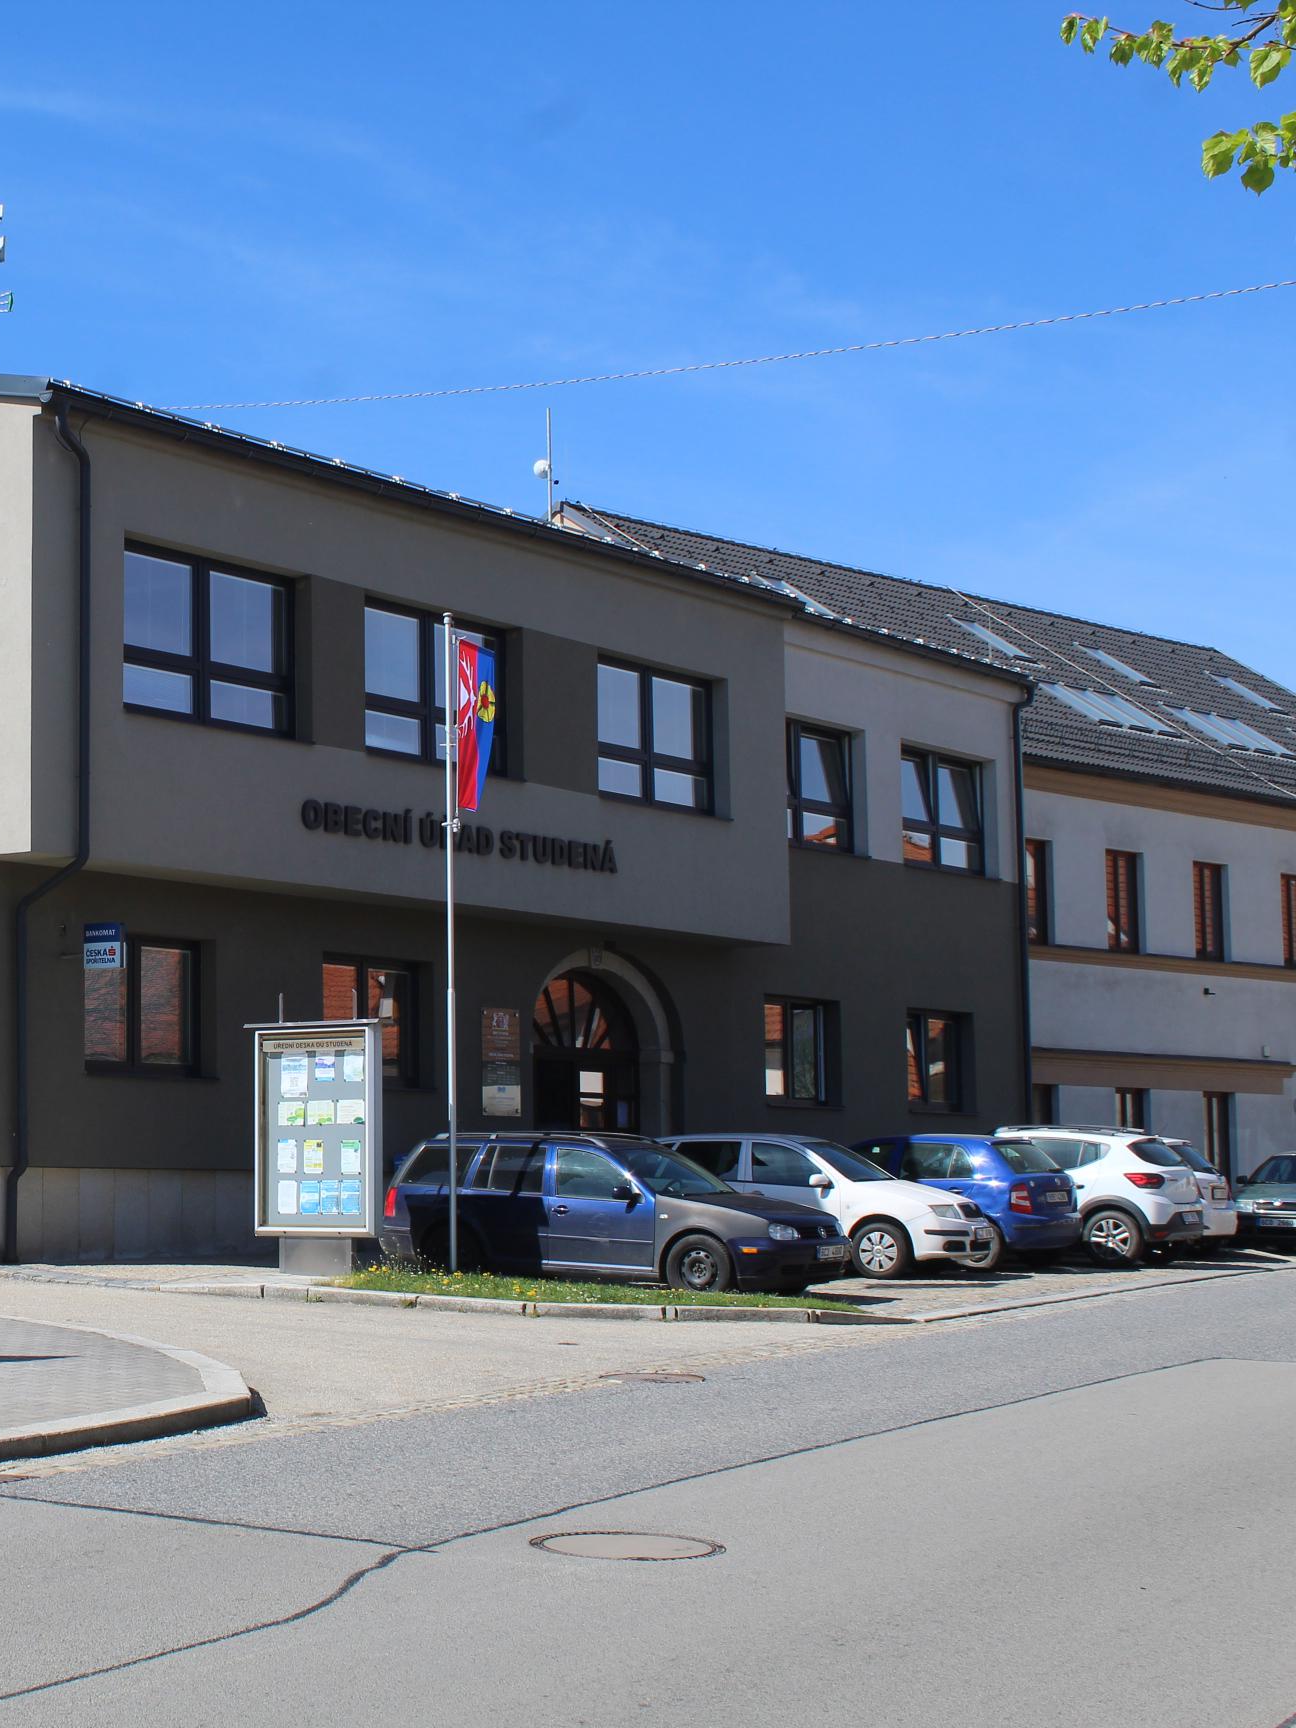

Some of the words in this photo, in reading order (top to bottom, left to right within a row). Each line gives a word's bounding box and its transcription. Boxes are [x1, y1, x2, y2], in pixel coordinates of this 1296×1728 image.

[301, 799, 414, 846] OBECNÍ
[498, 828, 619, 875] STUDENÁ
[85, 929, 115, 937] BANKOMAT
